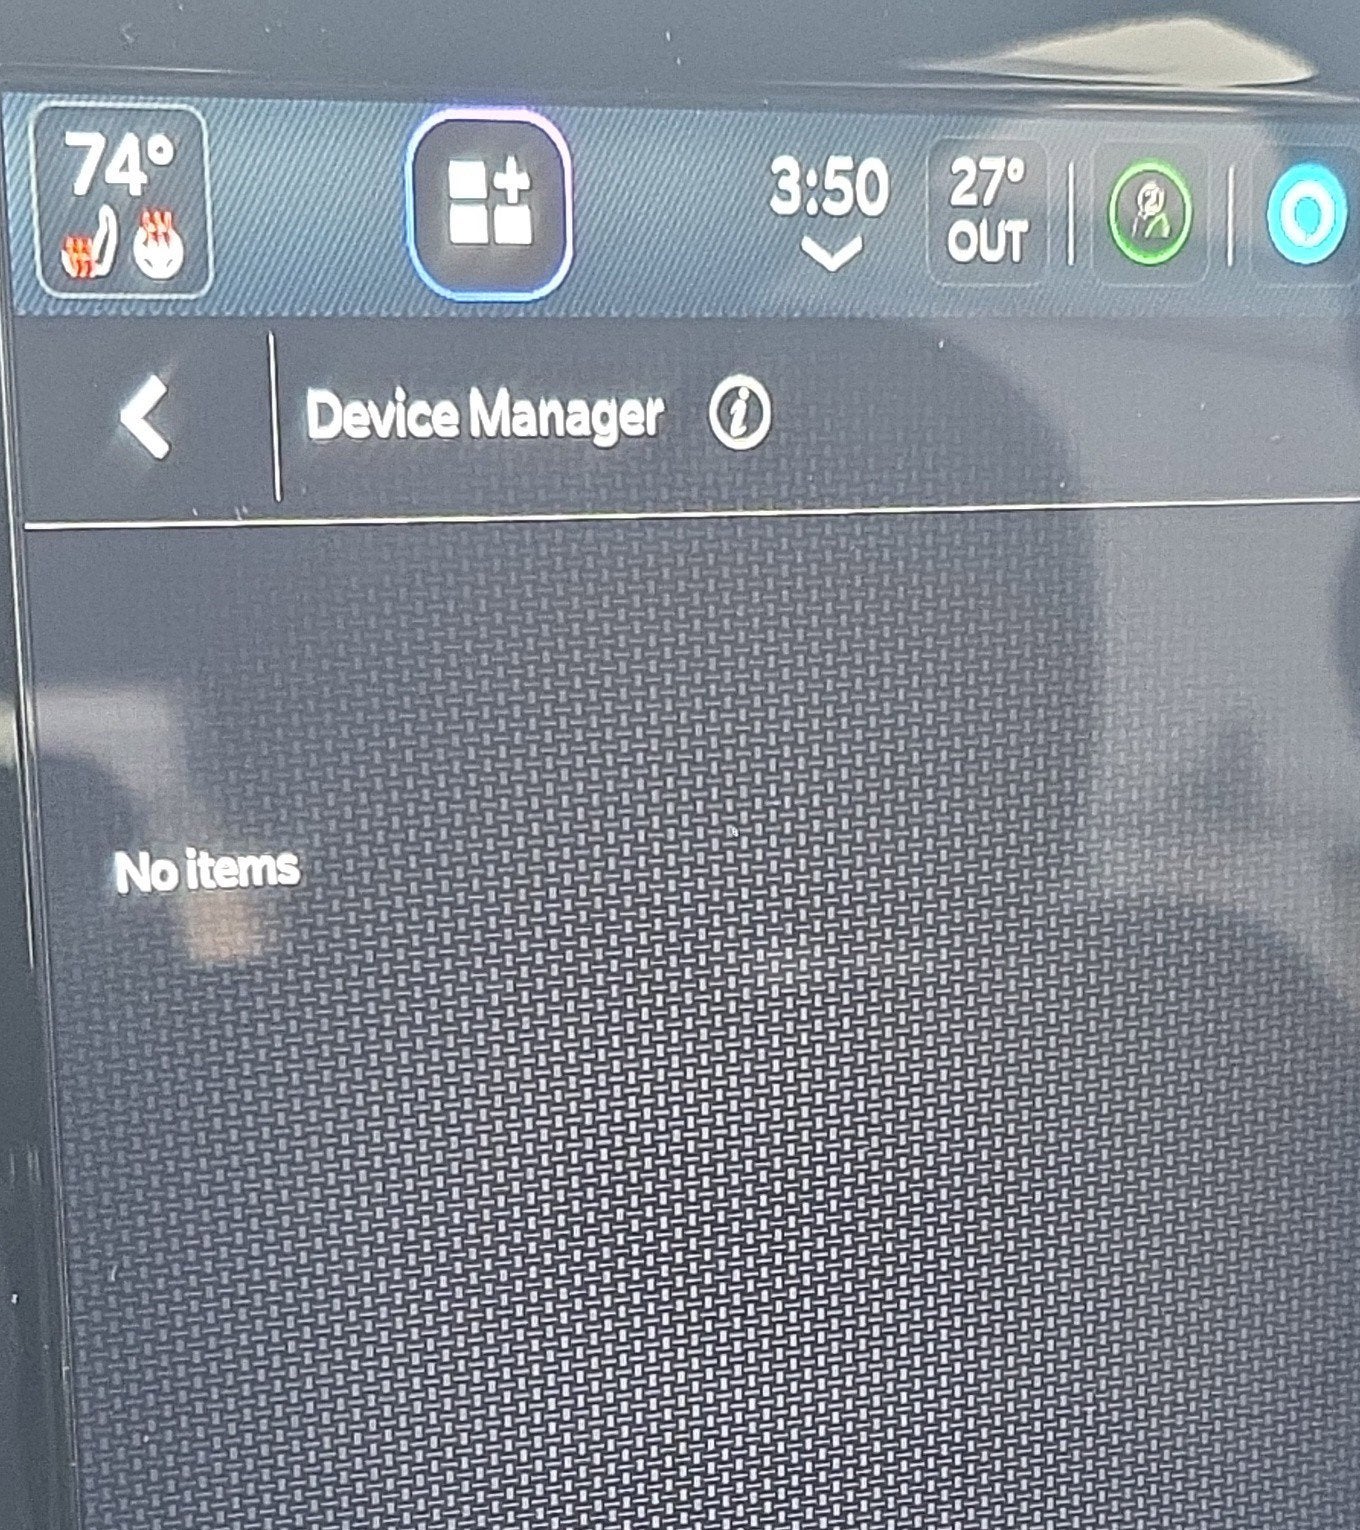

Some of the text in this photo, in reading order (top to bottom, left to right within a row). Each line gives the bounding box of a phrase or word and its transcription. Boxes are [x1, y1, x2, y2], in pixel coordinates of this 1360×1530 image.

[64, 131, 175, 197] 74°
[770, 155, 891, 217] 3:50
[949, 156, 1024, 206] 27°
[948, 220, 1029, 263] OUT
[307, 386, 665, 447] Device Manager
[116, 846, 301, 896] No items
